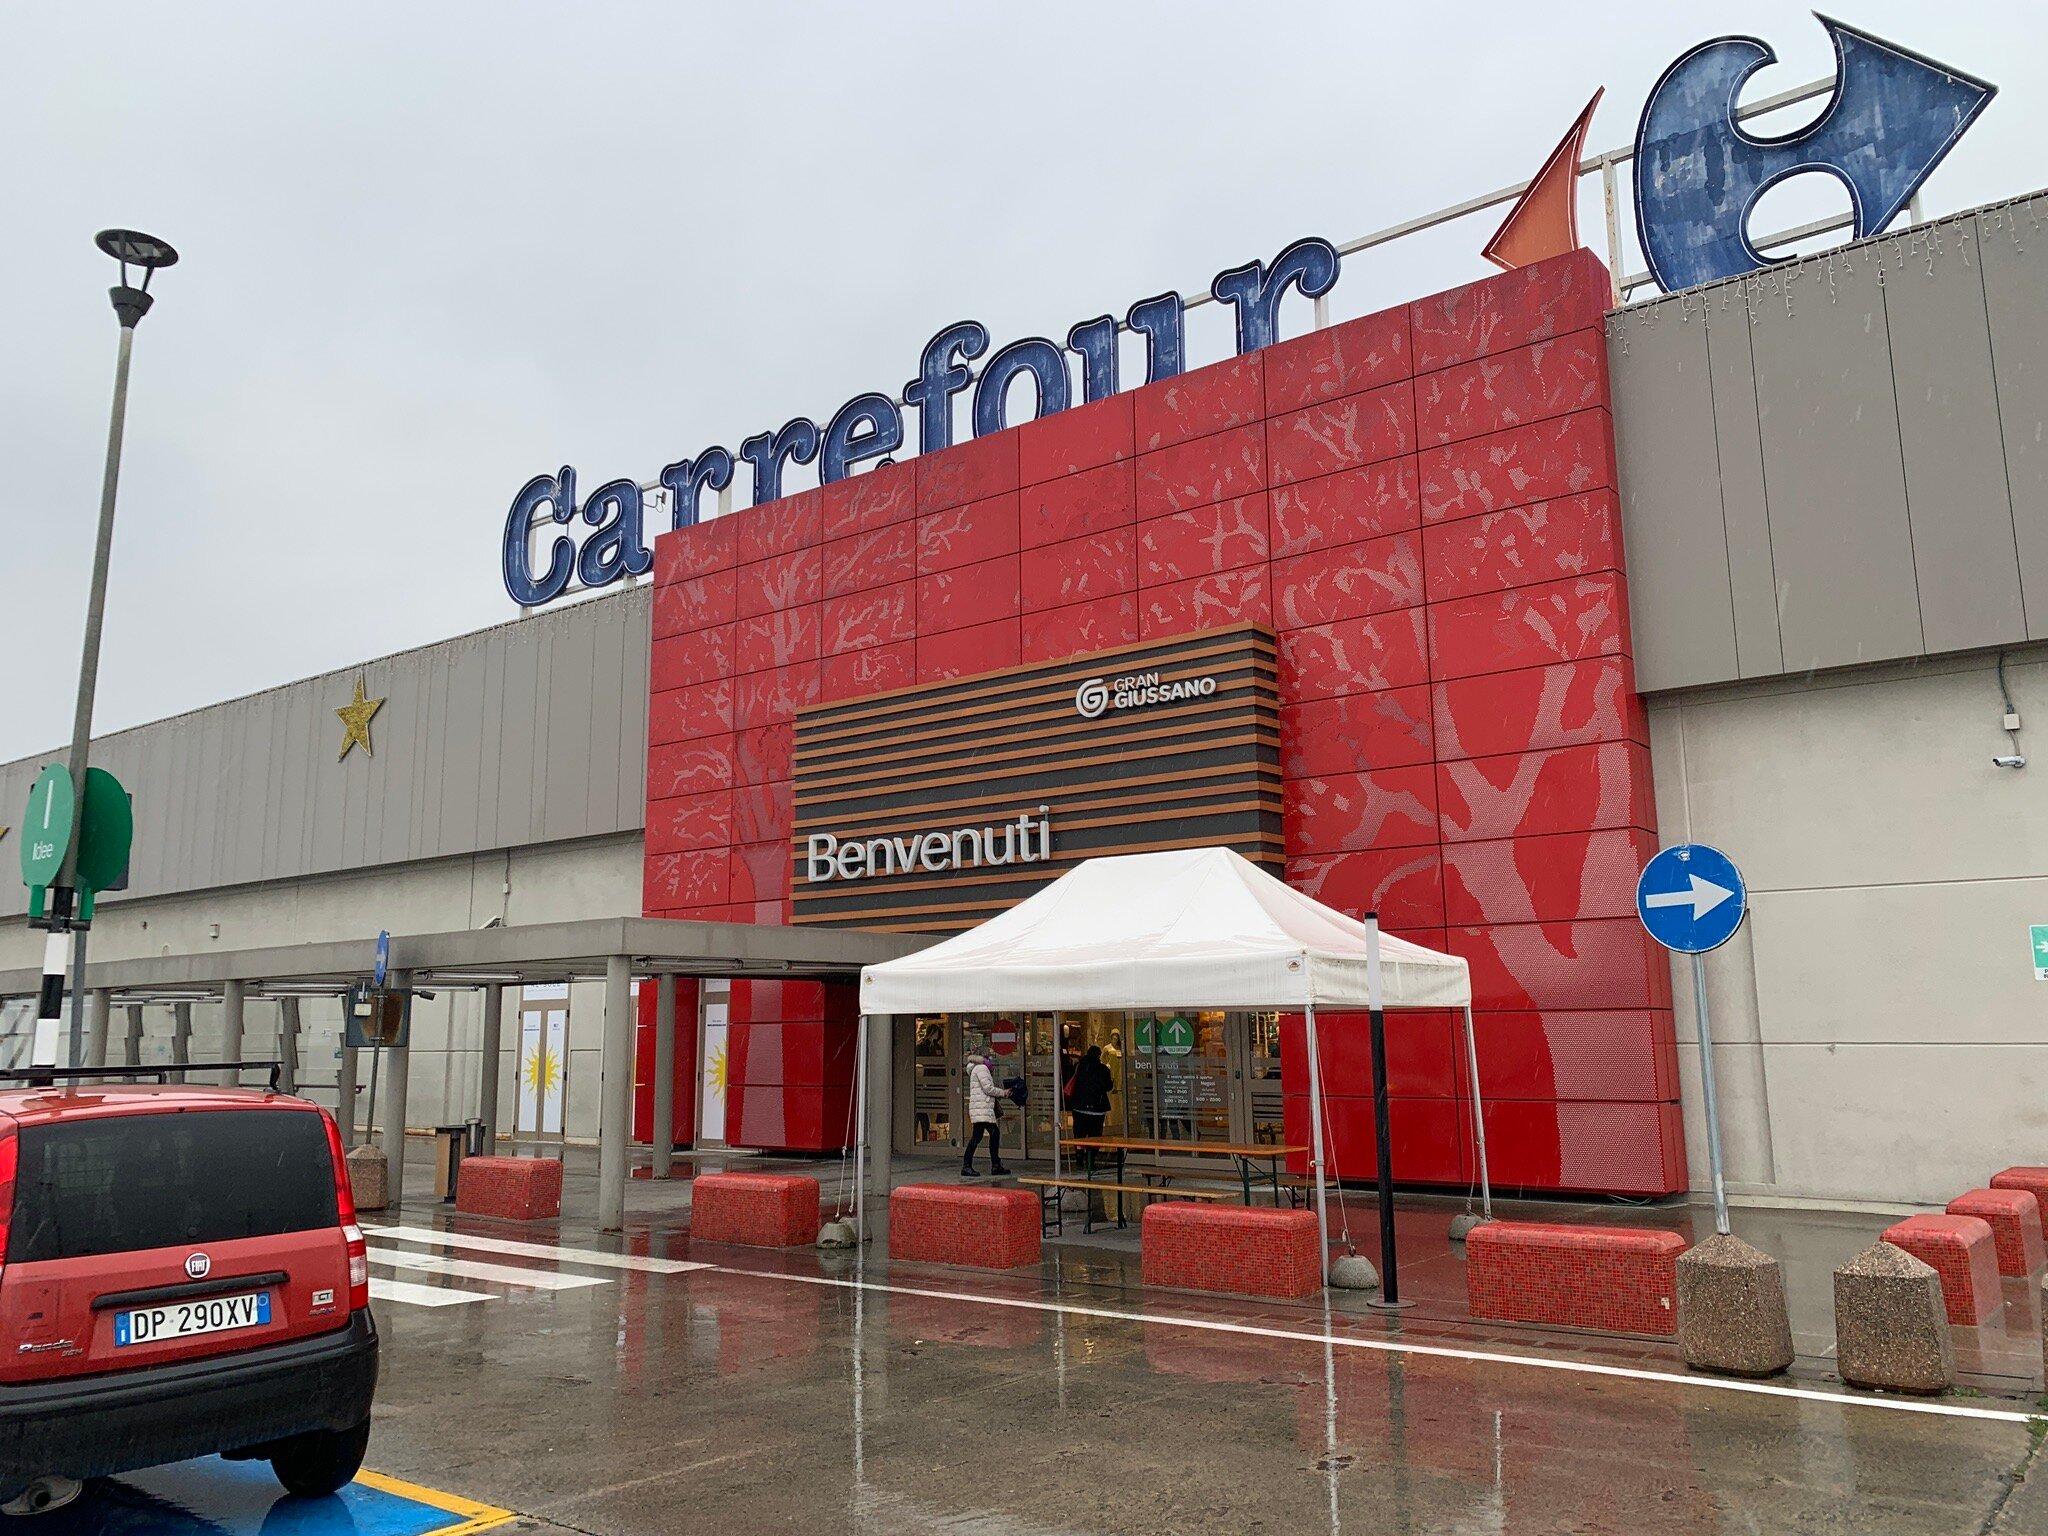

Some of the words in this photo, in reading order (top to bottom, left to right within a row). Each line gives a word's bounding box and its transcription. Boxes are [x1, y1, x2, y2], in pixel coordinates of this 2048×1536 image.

[503, 236, 1341, 608] Carrefour
[1114, 672, 1159, 692] GRAN
[1114, 677, 1217, 709] GIUSSANO
[807, 804, 1050, 882] Benvenuti
[191, 1259, 206, 1273] FIAT
[134, 1310, 166, 1340] DP
[178, 1297, 254, 1333] 290XV
